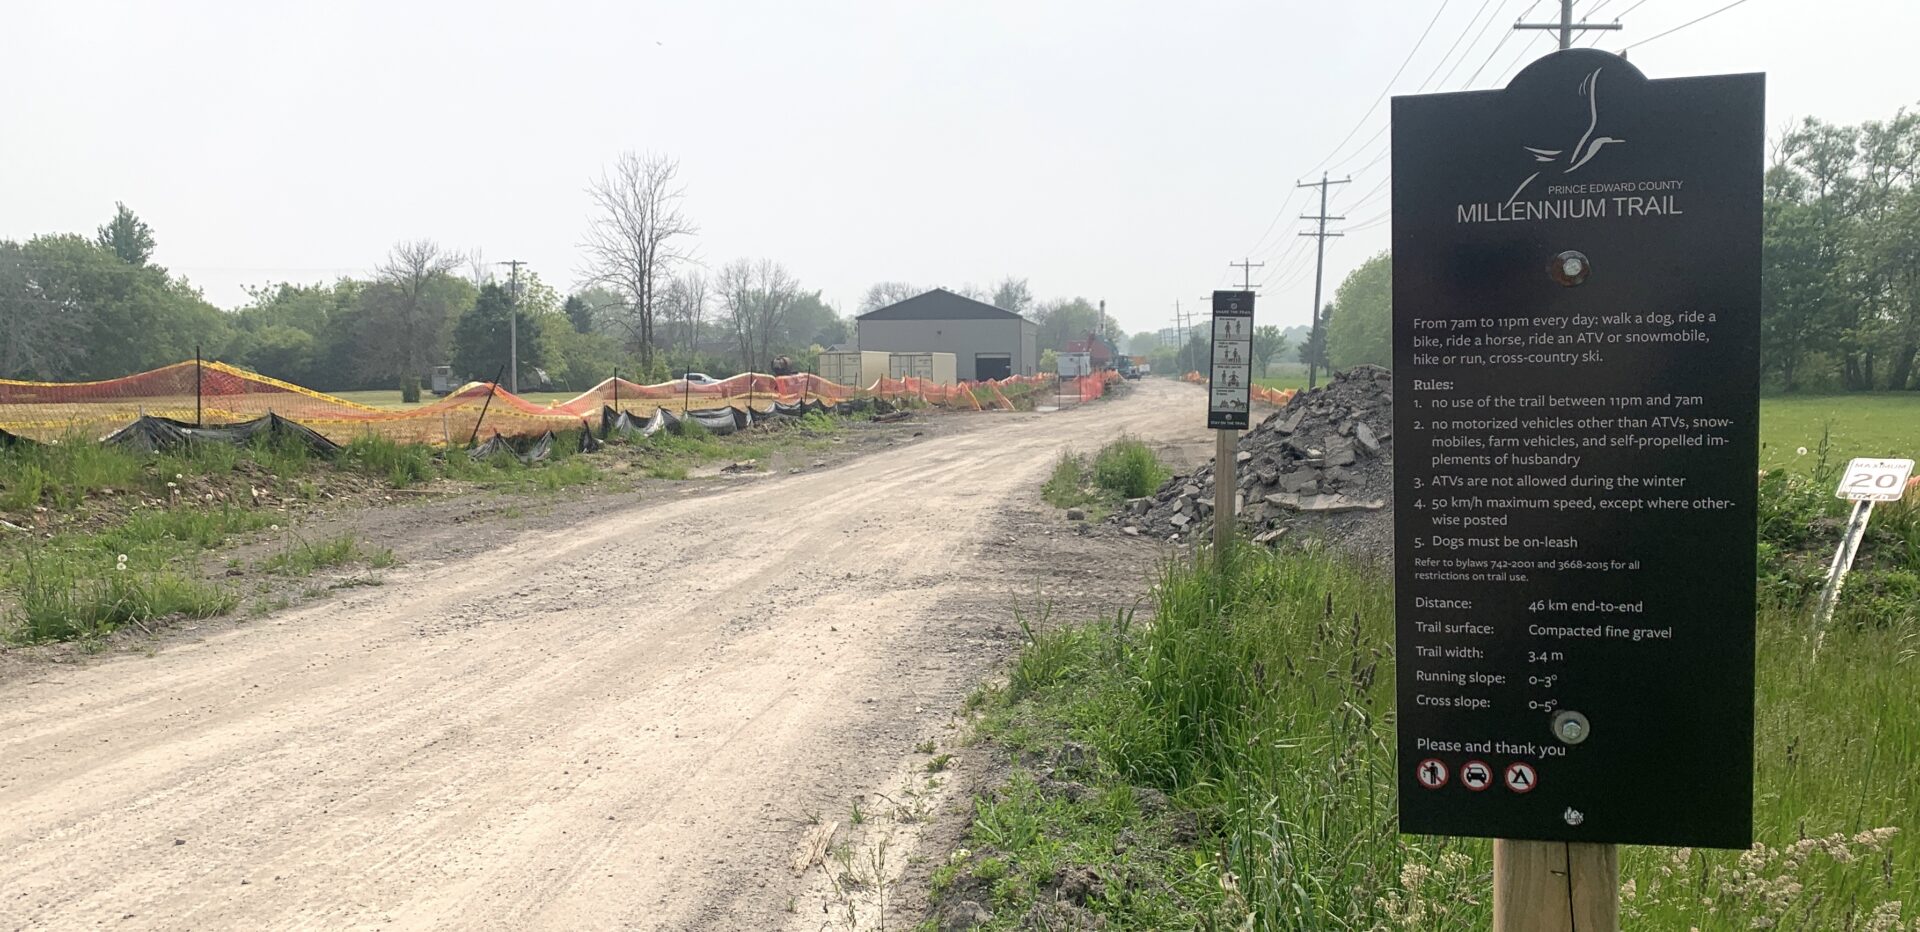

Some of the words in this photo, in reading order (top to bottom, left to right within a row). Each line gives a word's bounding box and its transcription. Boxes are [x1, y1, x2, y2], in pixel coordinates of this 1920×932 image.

[1548, 184, 1587, 195] PRINCE
[1589, 182, 1636, 193] EDWARD
[1638, 180, 1684, 191] COUNTY
[1458, 196, 1606, 223] MILLENNIUM
[1612, 195, 1683, 216] TRAIL
[1414, 318, 1447, 329] From
[1450, 319, 1477, 331] 7am
[1480, 318, 1494, 328] to
[1498, 317, 1529, 330] 11pm
[1532, 316, 1569, 329] every
[1572, 313, 1598, 328] day:
[1602, 312, 1632, 324] walk
[1635, 315, 1642, 324] a
[1646, 311, 1675, 327] dog,
[1678, 310, 1705, 323] ride
[1708, 313, 1716, 322] a
[1414, 335, 1443, 348] bike,
[1446, 334, 1471, 346] ride
[1474, 337, 1482, 346] a
[1485, 334, 1525, 347] horse,
[1529, 332, 1554, 344] ride
[1558, 335, 1573, 344] an
[1576, 332, 1604, 343] ATV
[1607, 334, 1622, 343] or
[1625, 329, 1710, 343] snowmobile,
[1414, 353, 1439, 365] hike
[1442, 356, 1457, 365] or
[1460, 355, 1486, 366] run,
[1489, 352, 1579, 366] cross-country
[1582, 350, 1603, 362] ski.
[1414, 379, 1454, 390] Rules:
[1414, 400, 1422, 408] 1.
[1432, 399, 1448, 408] no
[1452, 399, 1474, 408] use
[1477, 395, 1492, 408] of
[1494, 395, 1516, 408] the
[1519, 395, 1545, 407] trail
[1549, 395, 1606, 407] between
[1610, 397, 1642, 409] 11pm
[1646, 393, 1671, 406] and
[1674, 396, 1703, 408] 7am
[1414, 420, 1424, 430] 2.
[1432, 420, 1448, 430] no
[1452, 417, 1518, 430] motorized
[1521, 416, 1574, 429] vehicles
[1577, 416, 1614, 428] other
[1618, 416, 1648, 428] than
[1651, 416, 1689, 430] ATVs,
[1692, 418, 1734, 428] snow-
[1432, 436, 1485, 448] mobiles,
[1488, 435, 1520, 447] farm
[1522, 435, 1579, 448] vehicles,
[1582, 434, 1606, 446] and
[1610, 434, 1703, 450] self-propelled
[1707, 434, 1729, 446] im-
[1432, 453, 1491, 468] plements
[1494, 453, 1508, 465] of
[1512, 453, 1580, 468] husbandry
[1414, 477, 1424, 489] 3.
[1432, 475, 1464, 486] ATVs
[1467, 478, 1488, 486] are
[1492, 477, 1514, 486] not
[1516, 474, 1566, 487] allowed
[1570, 474, 1614, 490] during
[1617, 475, 1639, 487] the
[1642, 475, 1686, 487] winter
[1849, 473, 1898, 488] 20
[1414, 498, 1426, 510] 4.
[1432, 498, 1448, 510] 50
[1451, 496, 1482, 510] km/h
[1486, 496, 1550, 508] maximum
[1553, 496, 1596, 511] speed,
[1599, 498, 1644, 512] except
[1647, 497, 1689, 509] where
[1692, 497, 1736, 509] other-
[1432, 514, 1460, 525] wise
[1464, 514, 1508, 528] posted
[1414, 537, 1425, 548] 5.
[1432, 535, 1464, 550] Dogs
[1468, 537, 1500, 547] must
[1504, 536, 1520, 547] be
[1523, 536, 1578, 548] on-leash
[1414, 557, 1440, 567] Refer
[1456, 558, 1488, 570] bylaws
[1490, 560, 1534, 570] 742-2001
[1537, 559, 1556, 568] and
[1558, 560, 1609, 571] 3668-2015
[1610, 560, 1626, 570] for
[1628, 560, 1640, 570] all
[1414, 570, 1470, 581] restrictions
[1487, 572, 1506, 581] trail
[1415, 596, 1472, 609] Distance:
[1528, 600, 1545, 613] 46
[1548, 599, 1568, 611] km
[1571, 600, 1643, 613] end-to-end
[1415, 621, 1442, 632] Trail
[1444, 622, 1494, 634] surface:
[1528, 624, 1602, 639] Compacted
[1605, 625, 1630, 638] fine
[1632, 626, 1672, 642] gravel
[1415, 646, 1442, 657] Trail
[1445, 646, 1484, 658] width:
[1528, 651, 1548, 663] 3.4
[1551, 652, 1563, 660] m
[1416, 670, 1466, 686] Running
[1469, 671, 1506, 686] slope:
[1416, 694, 1451, 706] Cross
[1454, 695, 1490, 710] slope:
[1417, 737, 1462, 752] Please
[1465, 740, 1491, 753] and
[1495, 741, 1536, 755] thank
[1539, 746, 1566, 759] you
